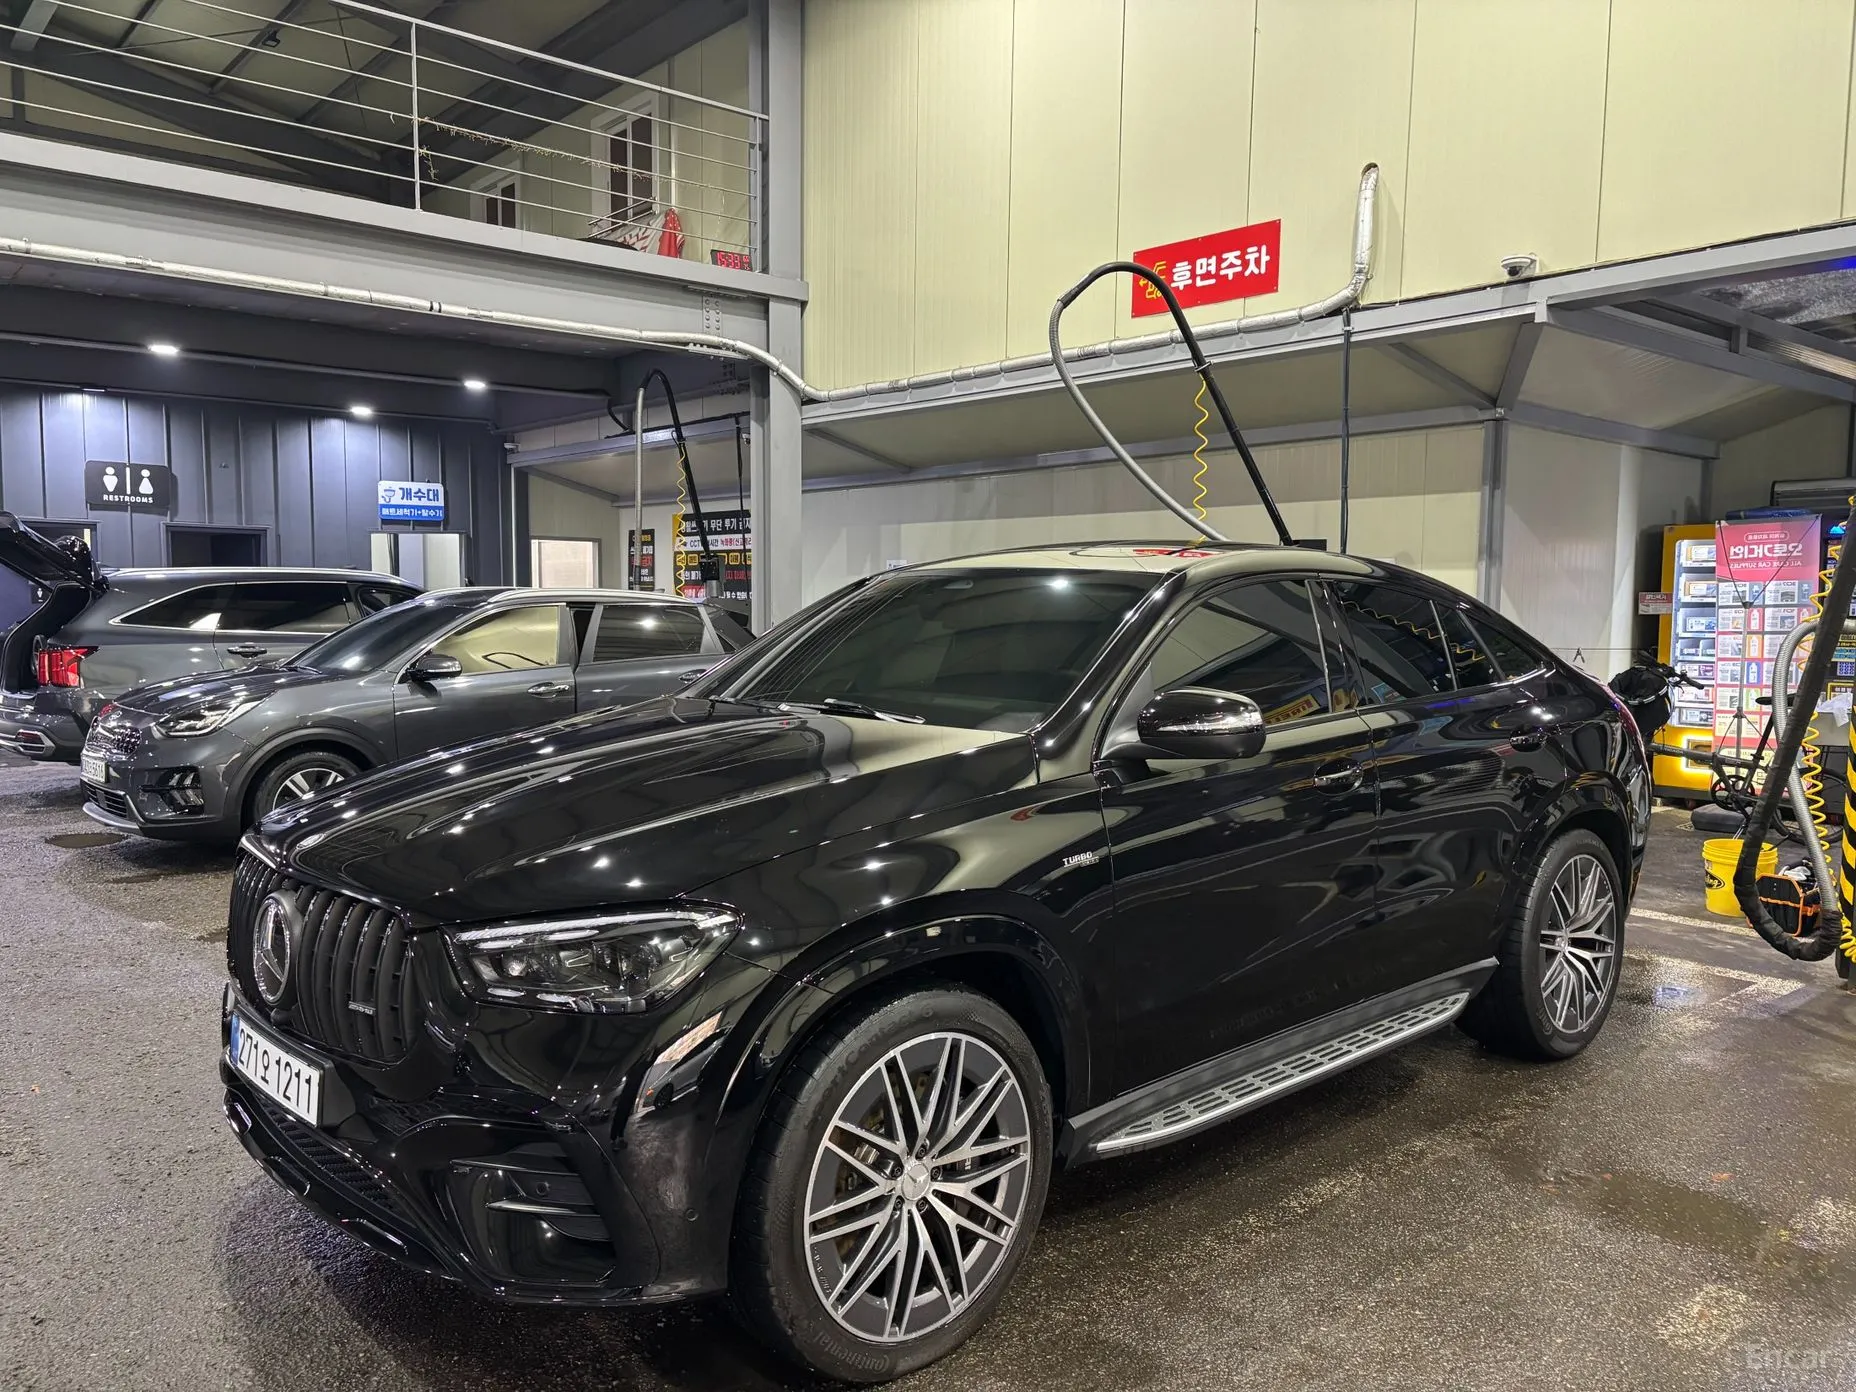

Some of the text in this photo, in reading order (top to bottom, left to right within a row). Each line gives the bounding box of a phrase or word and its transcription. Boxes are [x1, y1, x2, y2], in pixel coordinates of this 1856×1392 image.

[1170, 244, 1271, 291] 후면주차
[103, 494, 154, 503] RESTROOMS
[398, 487, 440, 502] 개수대
[710, 518, 723, 531] 무단
[724, 518, 737, 531] 투기
[1062, 851, 1093, 866] TURBO
[275, 1056, 313, 1114] 1211
[813, 1331, 890, 1374] Continental
